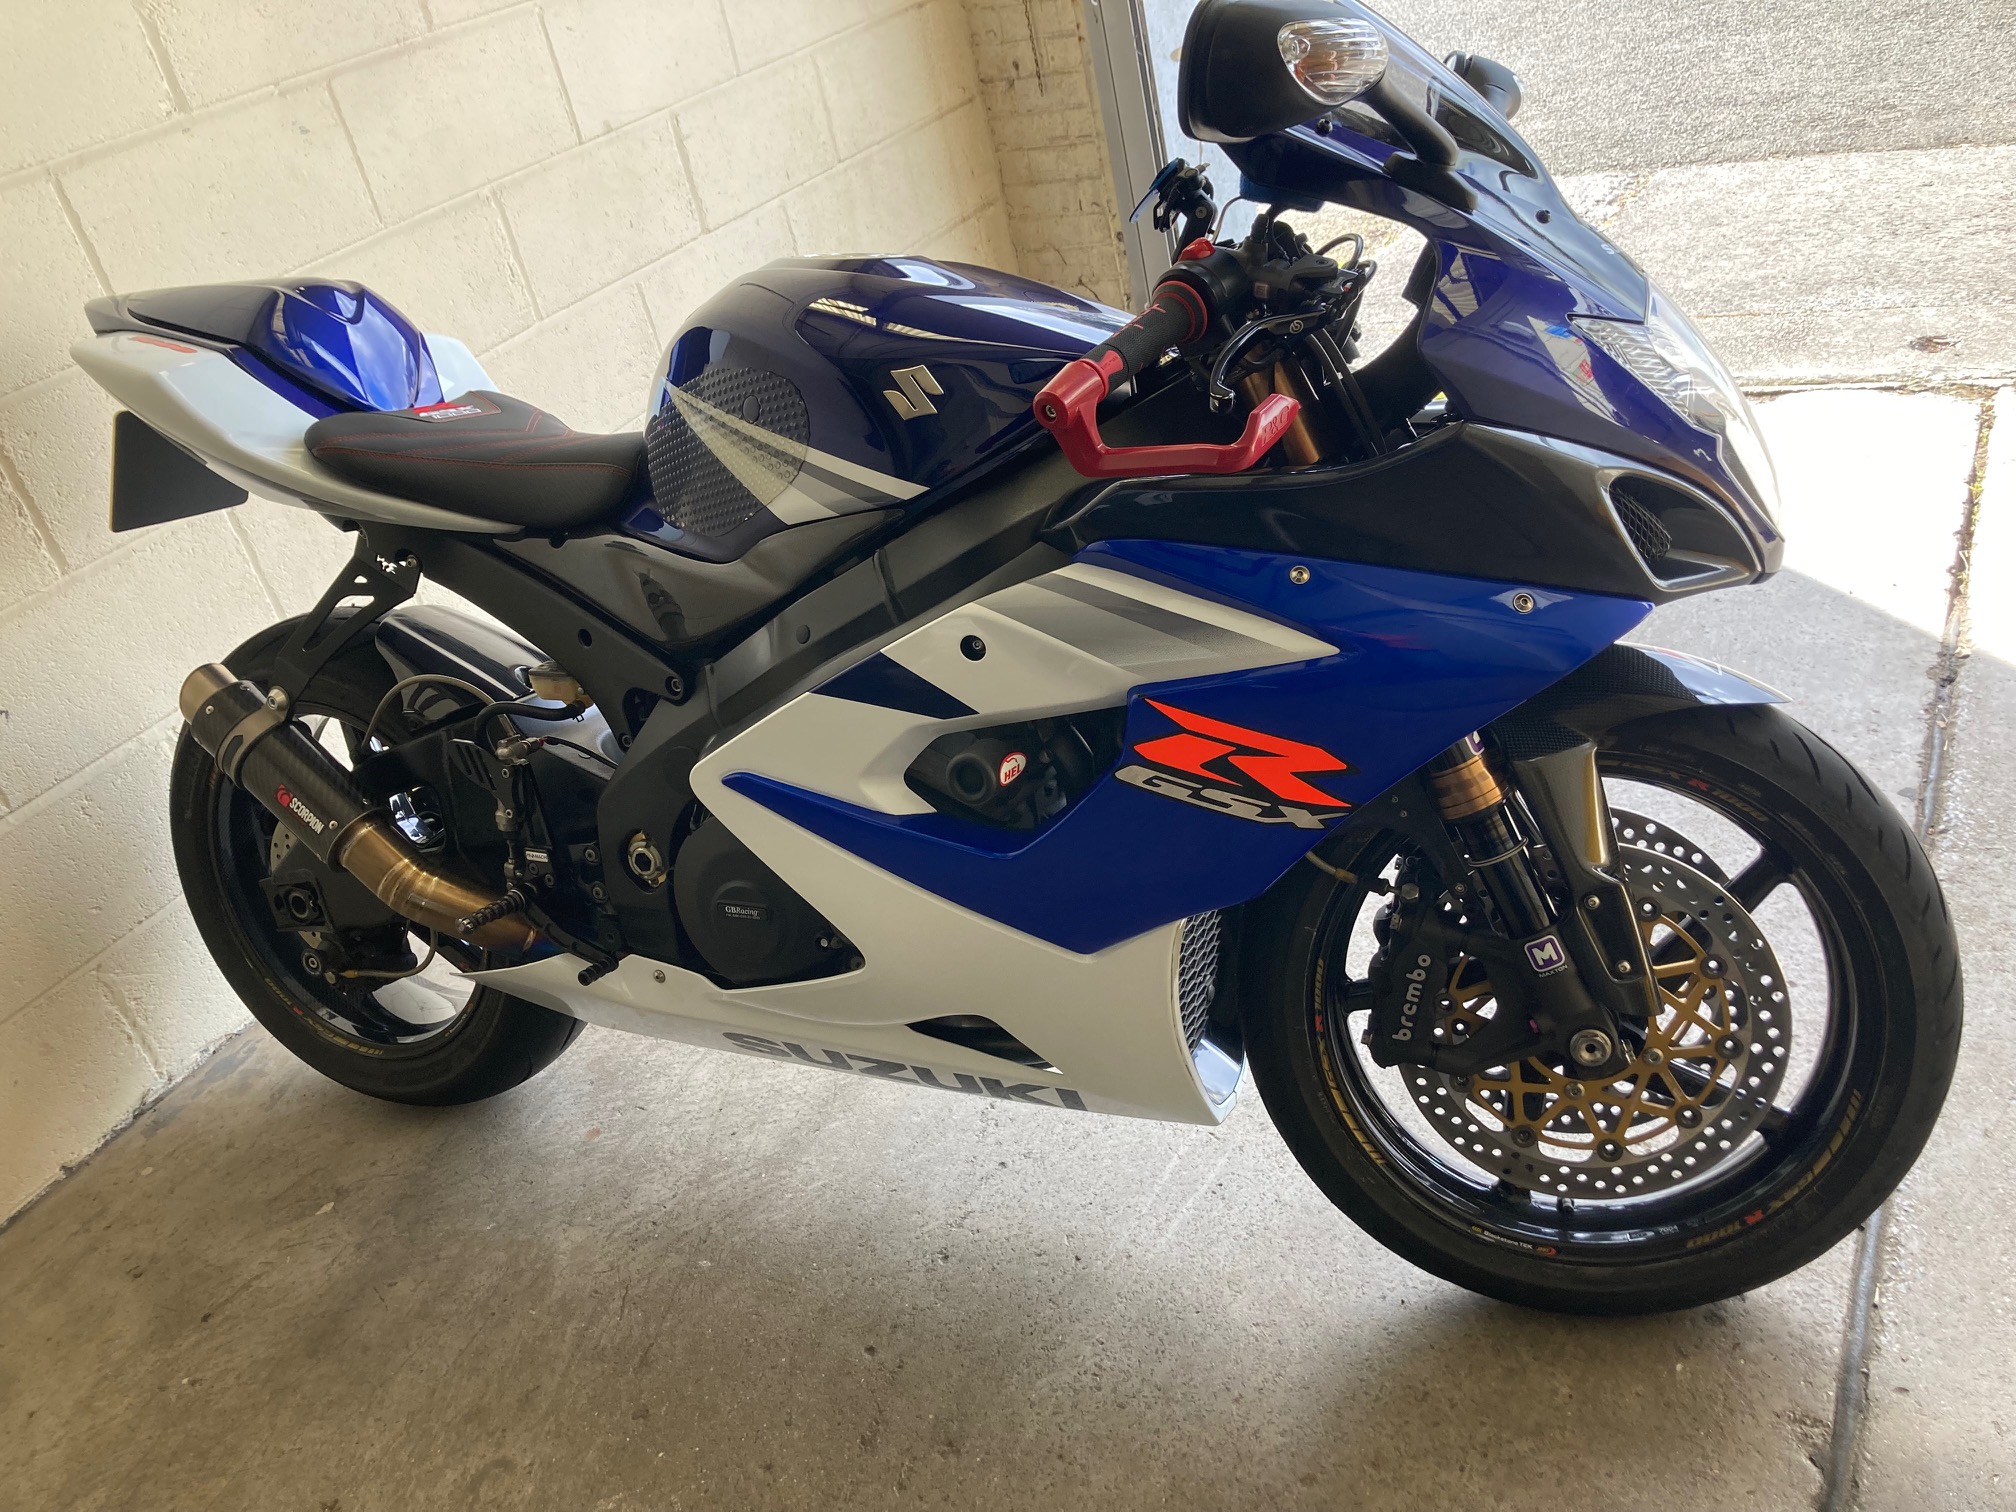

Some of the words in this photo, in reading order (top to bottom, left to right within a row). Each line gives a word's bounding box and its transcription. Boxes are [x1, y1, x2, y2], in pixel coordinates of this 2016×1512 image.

[1004, 764, 1022, 783] HEL
[1133, 698, 1352, 808] R
[289, 797, 325, 835] SCORPION
[1114, 765, 1350, 829] GSX
[725, 905, 760, 917] GBRacing
[1538, 964, 1568, 978] MAXTON
[1391, 954, 1432, 1041] brembo
[722, 1031, 1089, 1112] SUZUKI
